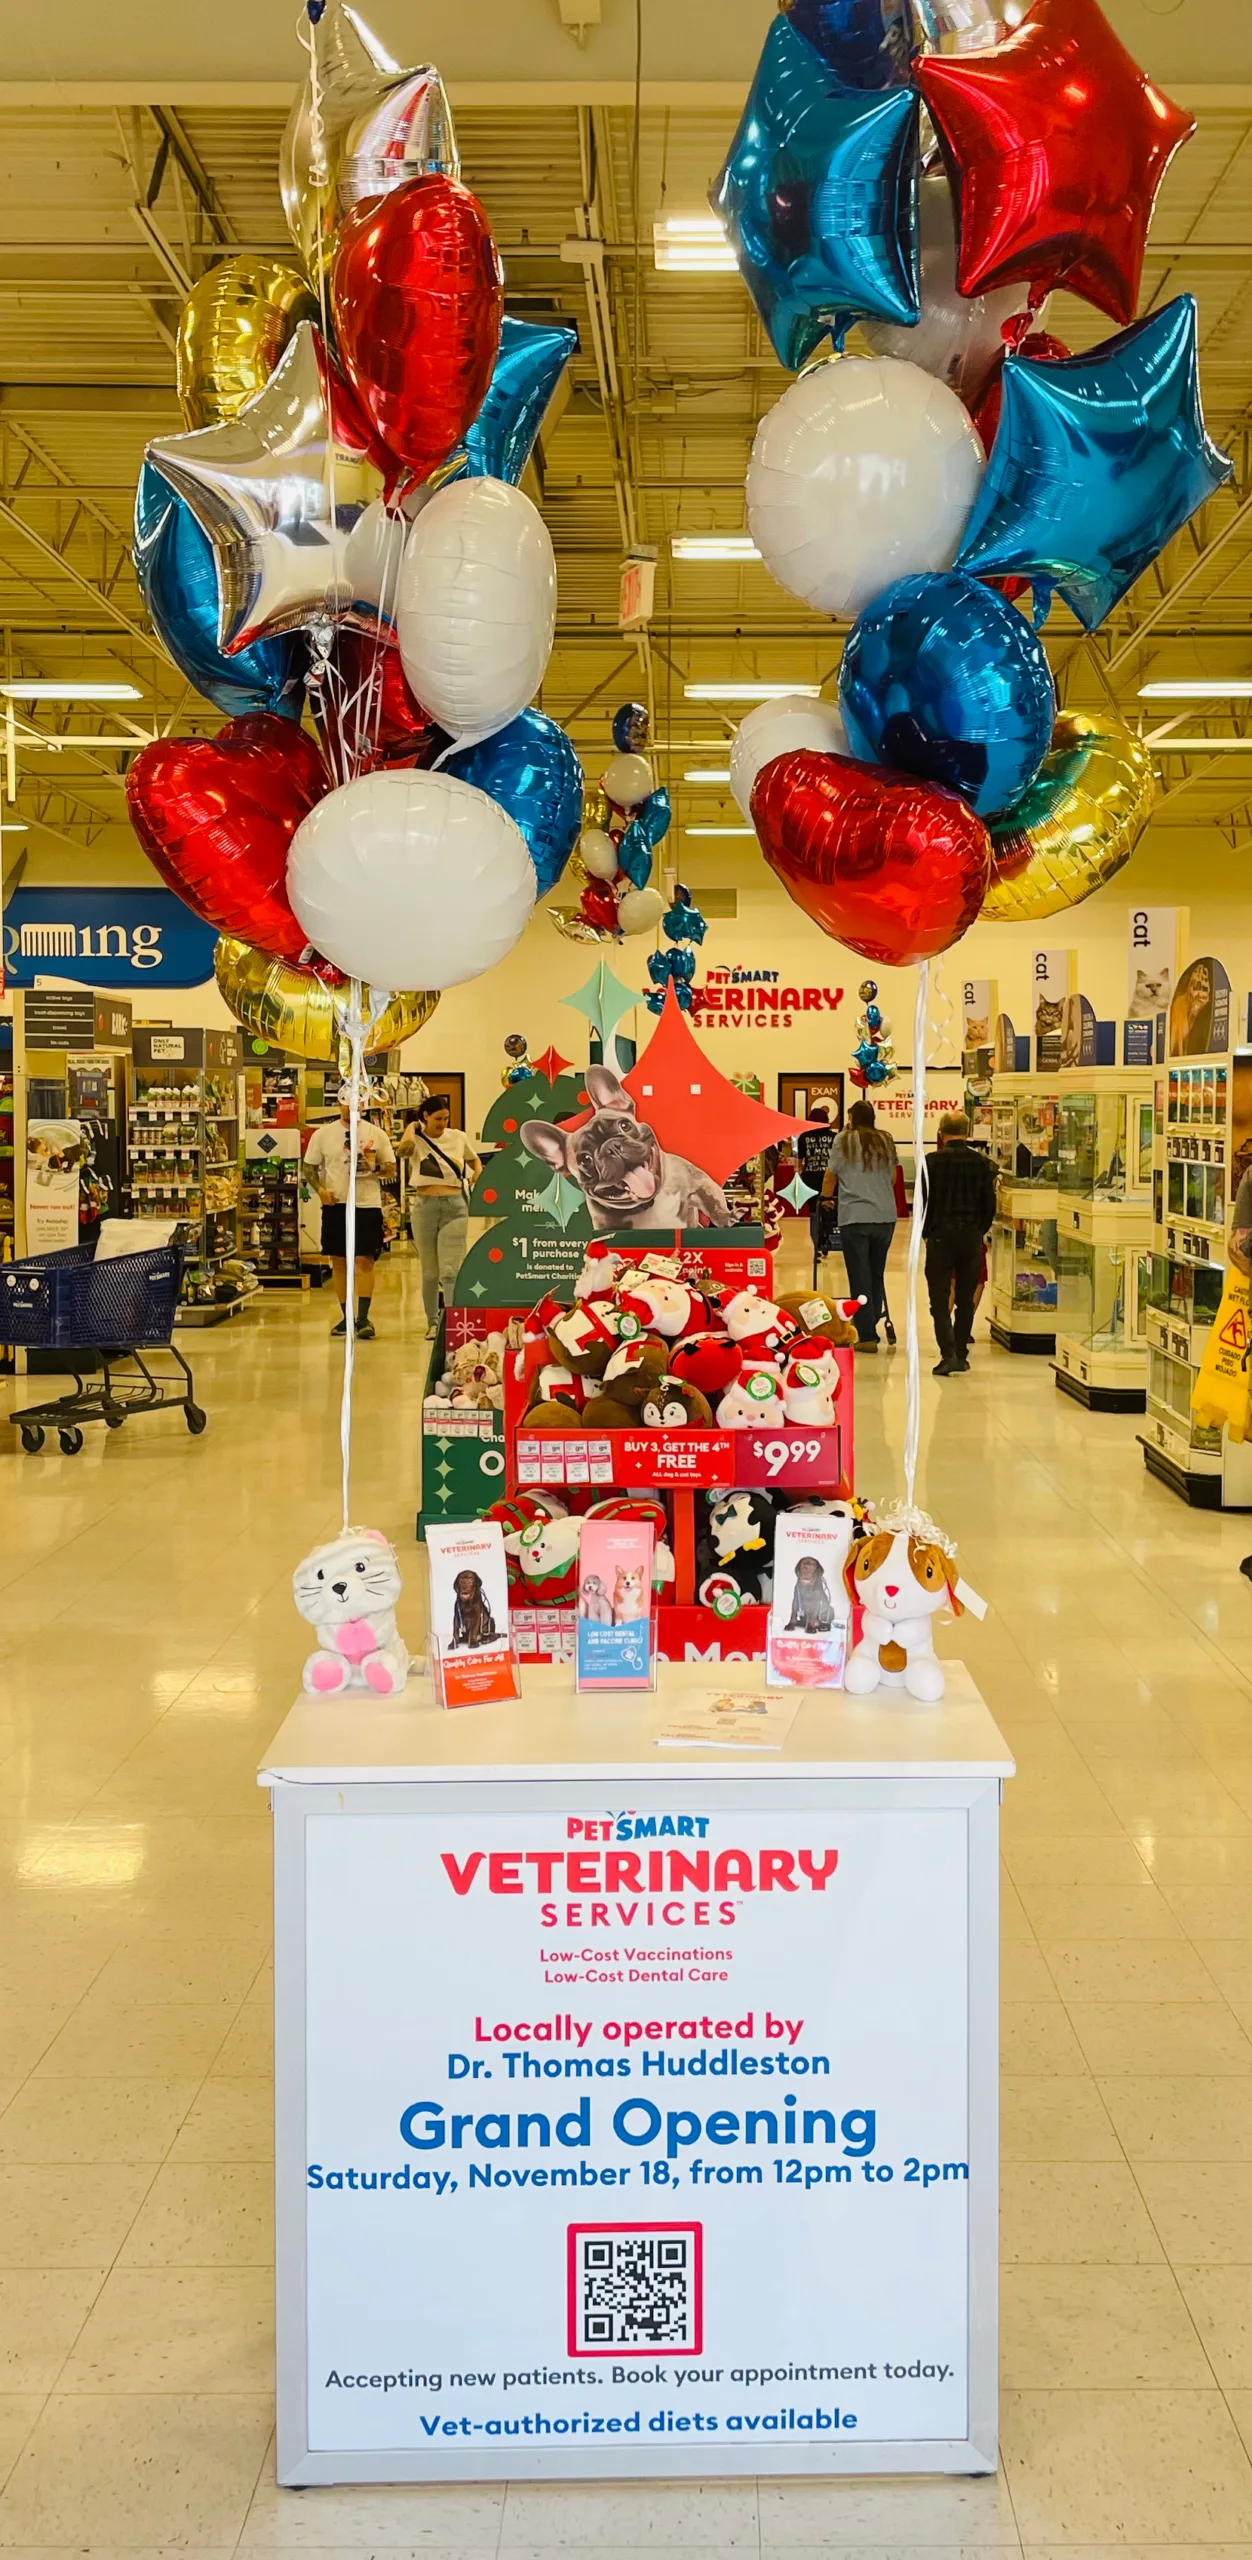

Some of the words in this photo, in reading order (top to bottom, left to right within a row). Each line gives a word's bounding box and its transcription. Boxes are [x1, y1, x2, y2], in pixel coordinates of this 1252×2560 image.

[1133, 912, 1150, 948] cat
[1036, 953, 1049, 981] cat
[36, 978, 43, 986] 5
[706, 969, 779, 985] PETSMART
[964, 982, 976, 1005] cat
[693, 1014, 793, 1028] SERVICES
[811, 1087, 838, 1096] EXAM
[512, 1237, 528, 1258] $1
[533, 1238, 557, 1247] from
[560, 1240, 588, 1250] every
[533, 1249, 580, 1260] purchase
[534, 1263, 564, 1271] donated
[566, 1263, 574, 1271] to
[683, 1252, 703, 1264] 2X
[515, 1272, 550, 1280] PetSmart
[624, 1442, 648, 1452] BUY
[651, 1442, 660, 1453] 3,
[663, 1442, 684, 1452] GET
[687, 1442, 709, 1452] THE
[712, 1442, 729, 1452] 4TH
[657, 1455, 696, 1468] FREE
[567, 1814, 709, 1841] PETSMART
[440, 1849, 838, 1895] VETERINARY
[540, 1949, 619, 1962] Low-Cost
[624, 1947, 733, 1961] Vaccinations
[545, 1970, 624, 1984] Low-Cost
[628, 1968, 684, 1982] Dental
[688, 1968, 728, 1982] Care
[475, 2014, 592, 2047] Locally
[603, 2012, 754, 2046] operated
[765, 2012, 804, 2043] by
[447, 2054, 492, 2079] Dr.
[502, 2051, 631, 2078] Thomas
[642, 2050, 830, 2077] Huddleston
[400, 2097, 592, 2150] Grand
[612, 2094, 877, 2158] Opening
[307, 2163, 458, 2195] Saturday,
[469, 2161, 628, 2188] November
[640, 2161, 679, 2189] 18,
[690, 2158, 762, 2185] from
[774, 2159, 852, 2188] 12pm
[861, 2160, 891, 2183] to
[902, 2158, 970, 2187] 2pm
[325, 2368, 442, 2392] Accepting
[450, 2371, 496, 2388] new
[503, 2366, 603, 2389] patients.
[611, 2363, 667, 2384] Book
[674, 2366, 723, 2388] your
[730, 2361, 876, 2387] appointment
[884, 2359, 954, 2383] today.
[420, 2411, 640, 2436] Vet-authorized
[649, 2409, 718, 2433] diets
[726, 2407, 857, 2431] available
